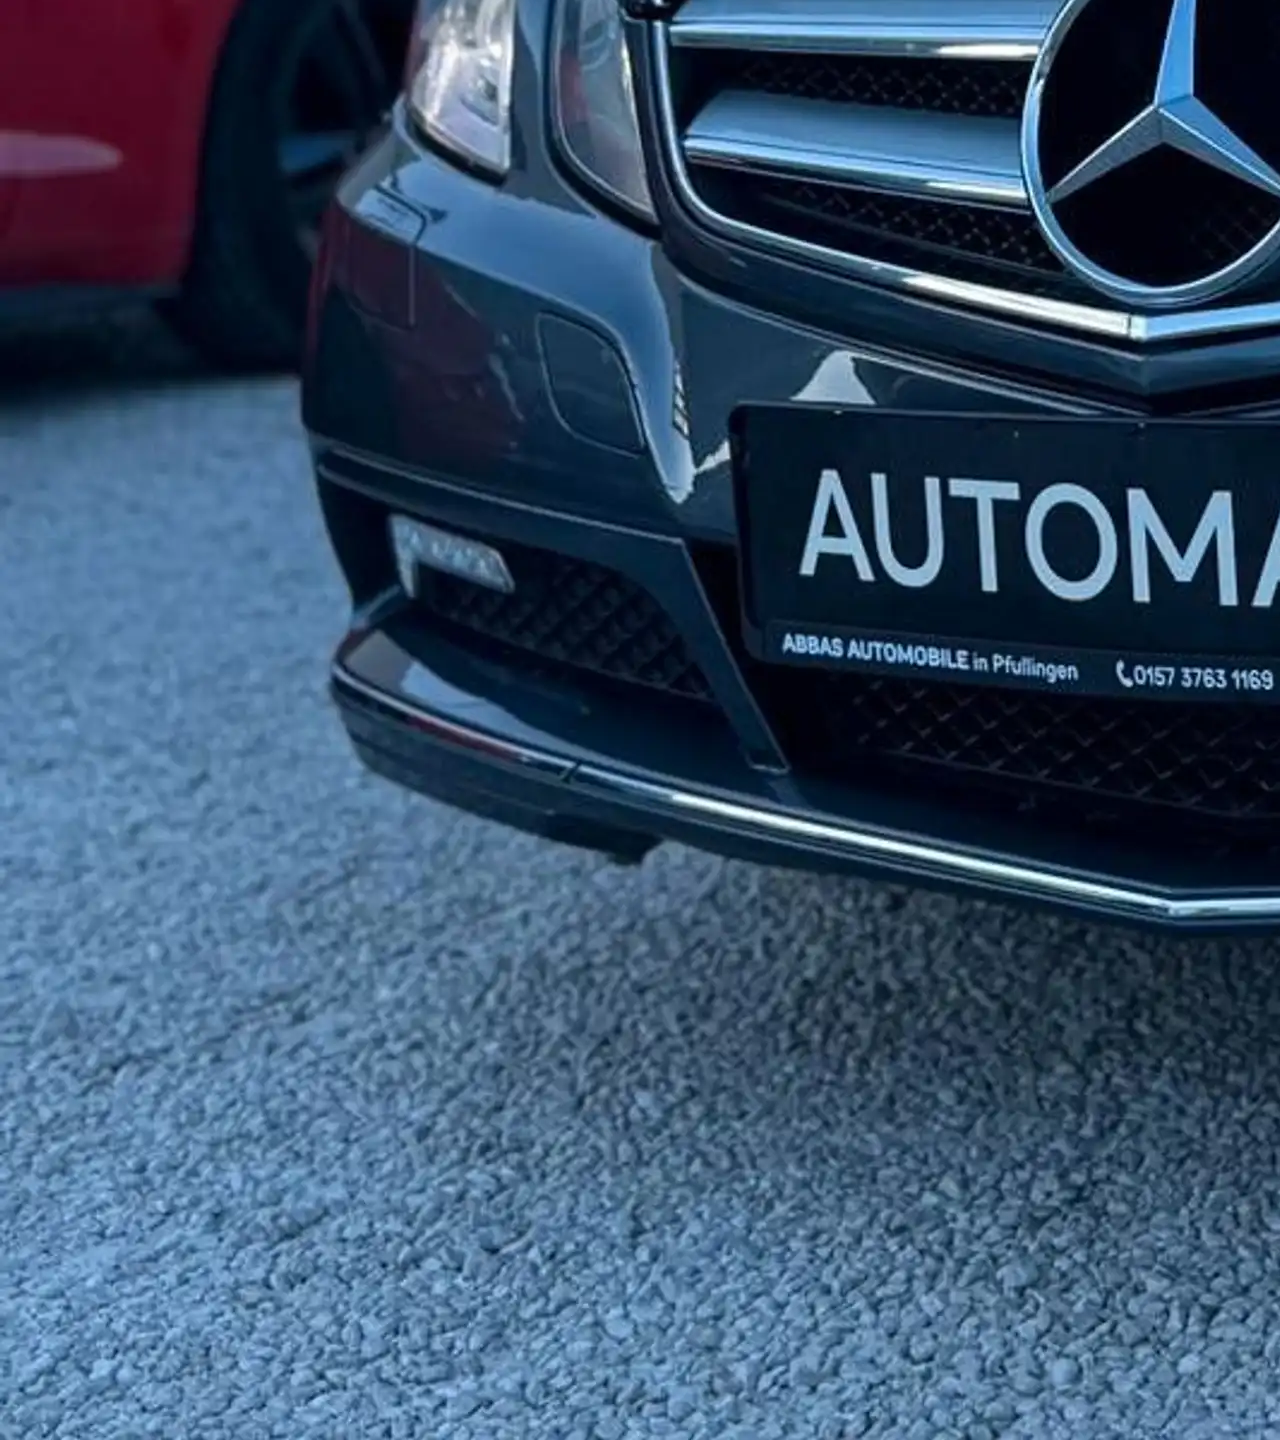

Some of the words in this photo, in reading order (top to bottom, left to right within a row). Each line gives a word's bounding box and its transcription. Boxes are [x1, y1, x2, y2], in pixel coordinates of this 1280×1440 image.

[781, 632, 845, 659] ABBAS
[846, 637, 971, 671] AUTOMOBILE
[972, 651, 990, 672] in
[991, 652, 1080, 685] Pfullingen
[1133, 664, 1176, 687] 0157
[1180, 666, 1228, 690] 3763
[1230, 668, 1275, 691] 1169
